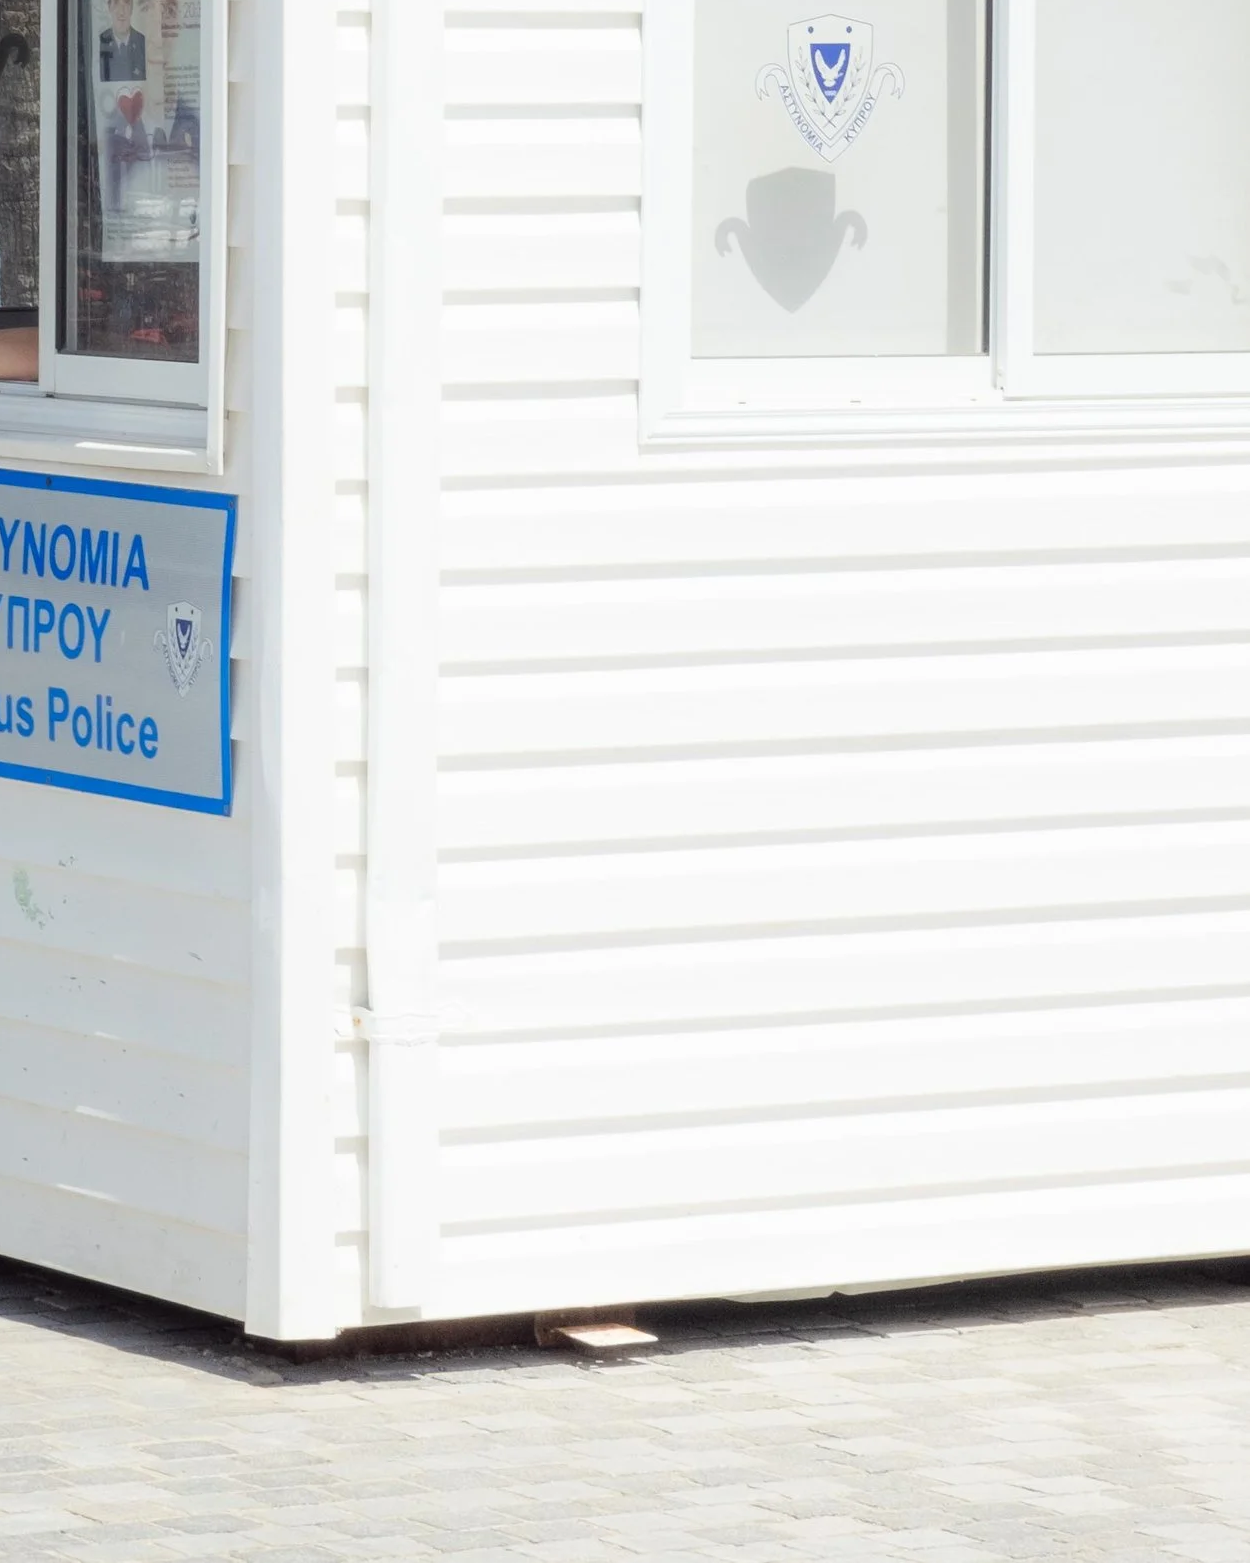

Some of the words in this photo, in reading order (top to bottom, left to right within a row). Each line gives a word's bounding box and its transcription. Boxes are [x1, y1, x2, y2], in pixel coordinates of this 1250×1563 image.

[780, 85, 824, 151] ΑΣΤΥΝΟΜΙΑ
[843, 92, 879, 143] ΚΥΠΡΟΥ
[48, 686, 158, 759] Police
